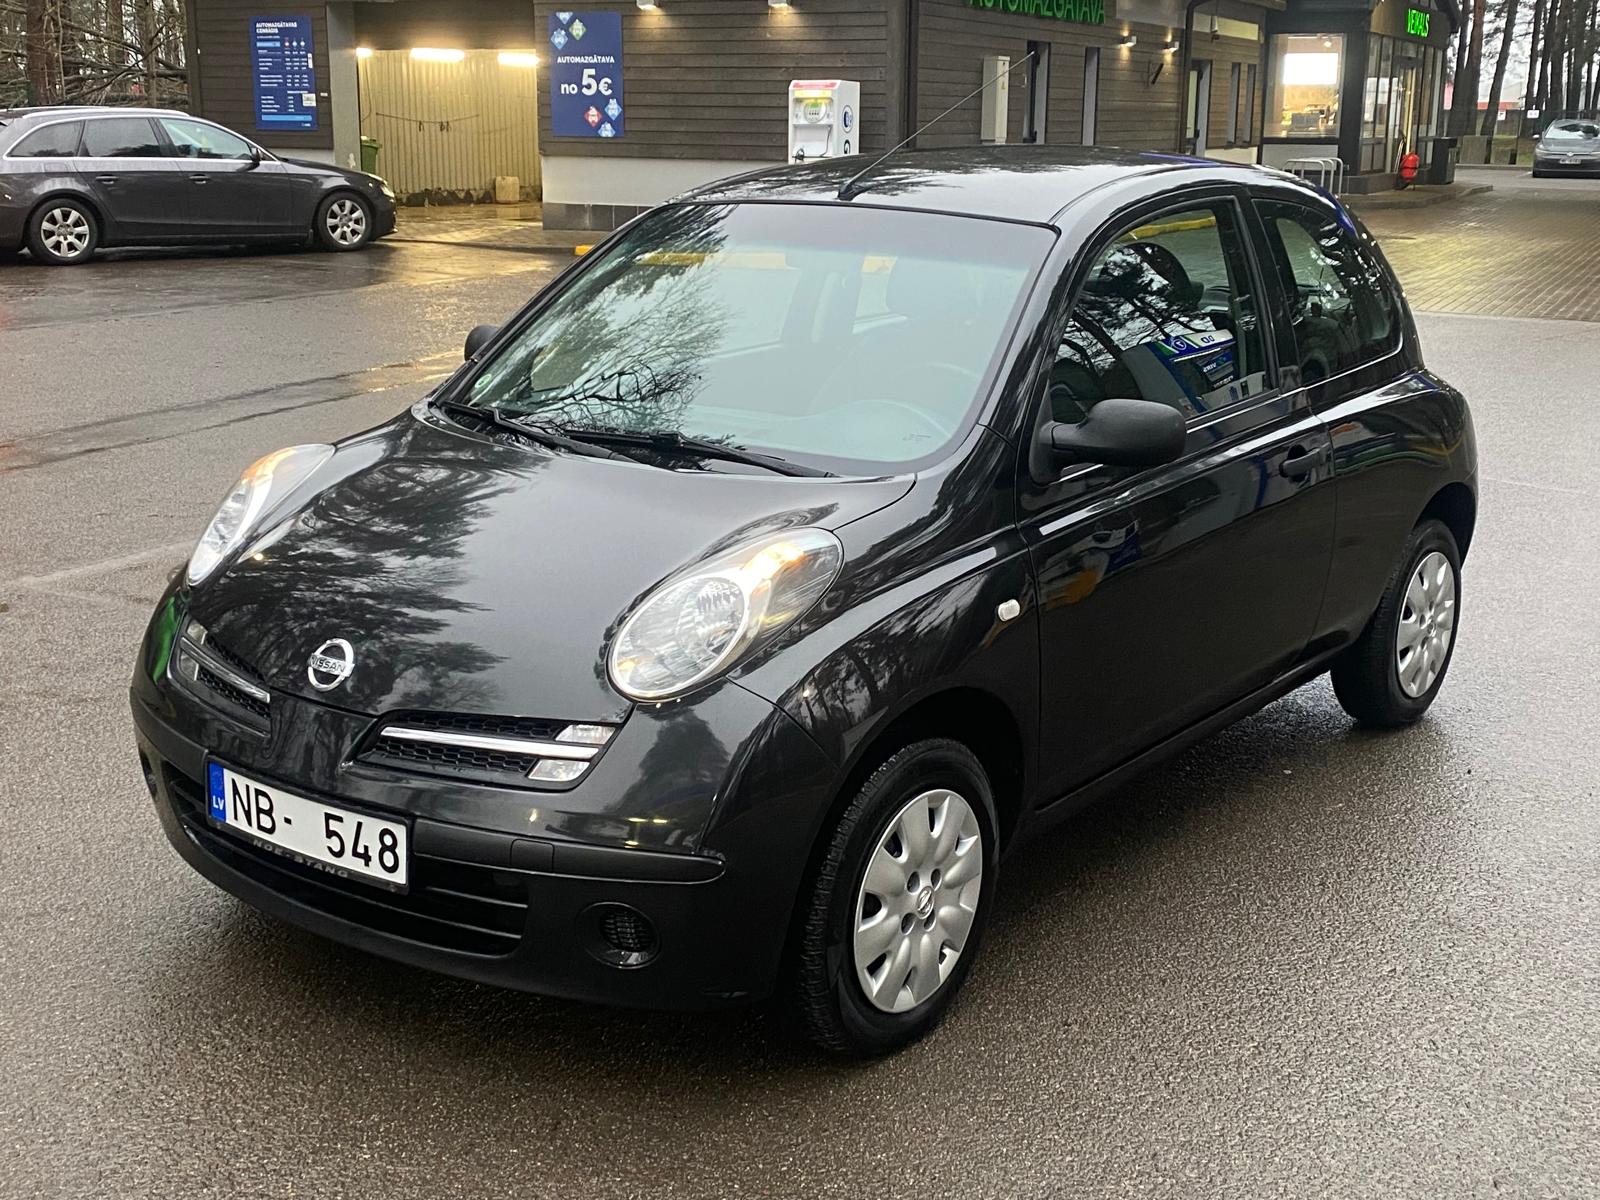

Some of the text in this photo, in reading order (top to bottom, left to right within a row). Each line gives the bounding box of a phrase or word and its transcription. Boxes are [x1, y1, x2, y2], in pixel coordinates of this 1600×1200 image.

[556, 54, 615, 64] AUTOMAZGĀTAVA
[560, 68, 613, 96] no 5€
[310, 654, 346, 673] NISSAN
[212, 795, 225, 810] LV
[323, 811, 399, 874] 548
